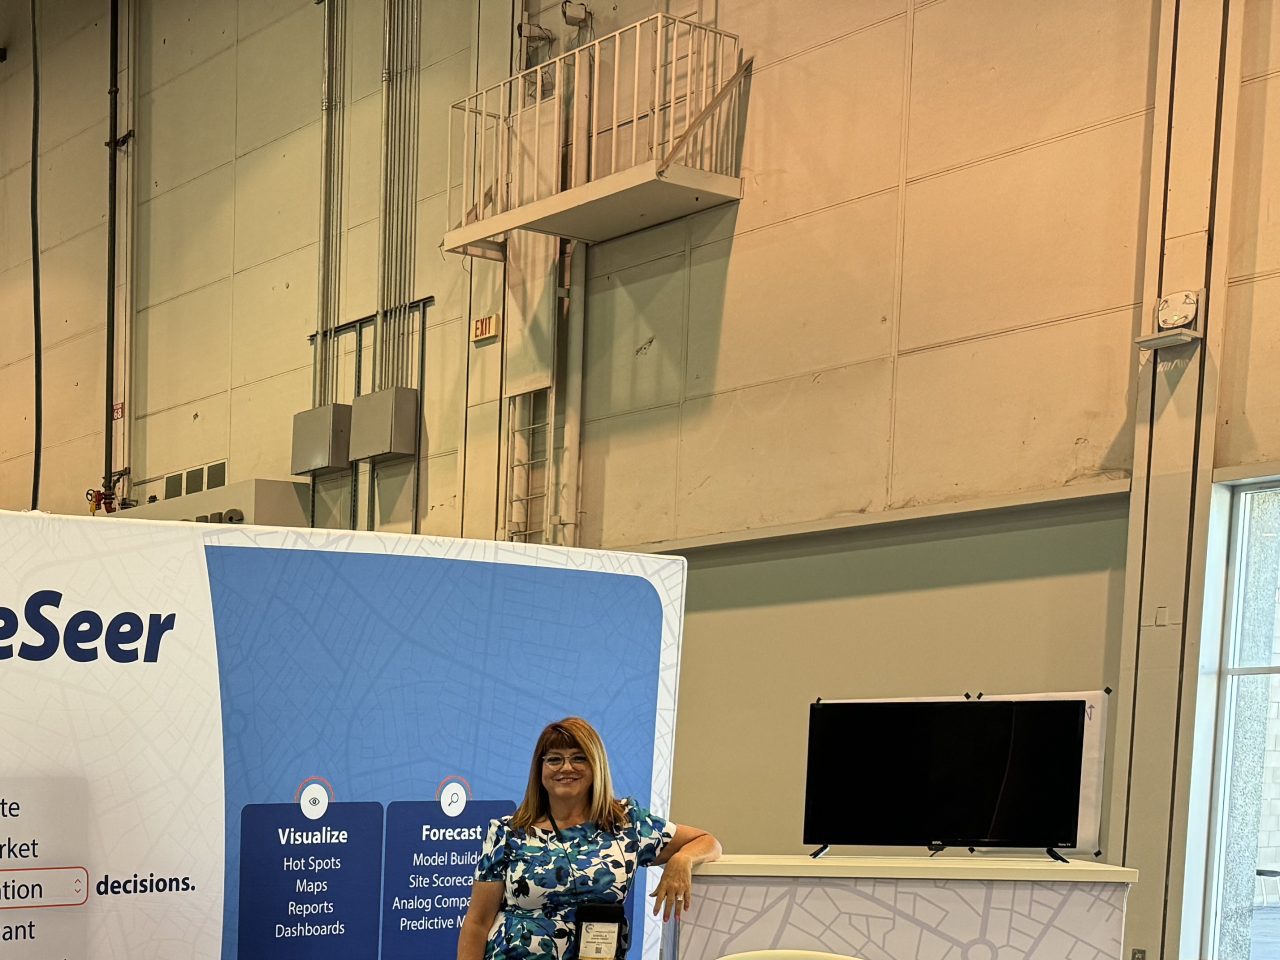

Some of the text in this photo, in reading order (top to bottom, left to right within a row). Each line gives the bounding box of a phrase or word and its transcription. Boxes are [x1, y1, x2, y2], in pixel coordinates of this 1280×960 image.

[474, 315, 493, 339] EXIT
[278, 827, 348, 845] Visualize
[422, 825, 483, 841] Forecast
[283, 856, 341, 873] Hot Spots
[413, 851, 448, 866] Model
[95, 872, 197, 896] decisions.
[295, 878, 328, 895] Maps
[408, 874, 474, 888] Site Scoreca
[288, 900, 334, 918] Reports
[392, 895, 432, 912] Analog
[275, 921, 345, 938] Dashboards
[400, 916, 454, 931] Predictive
